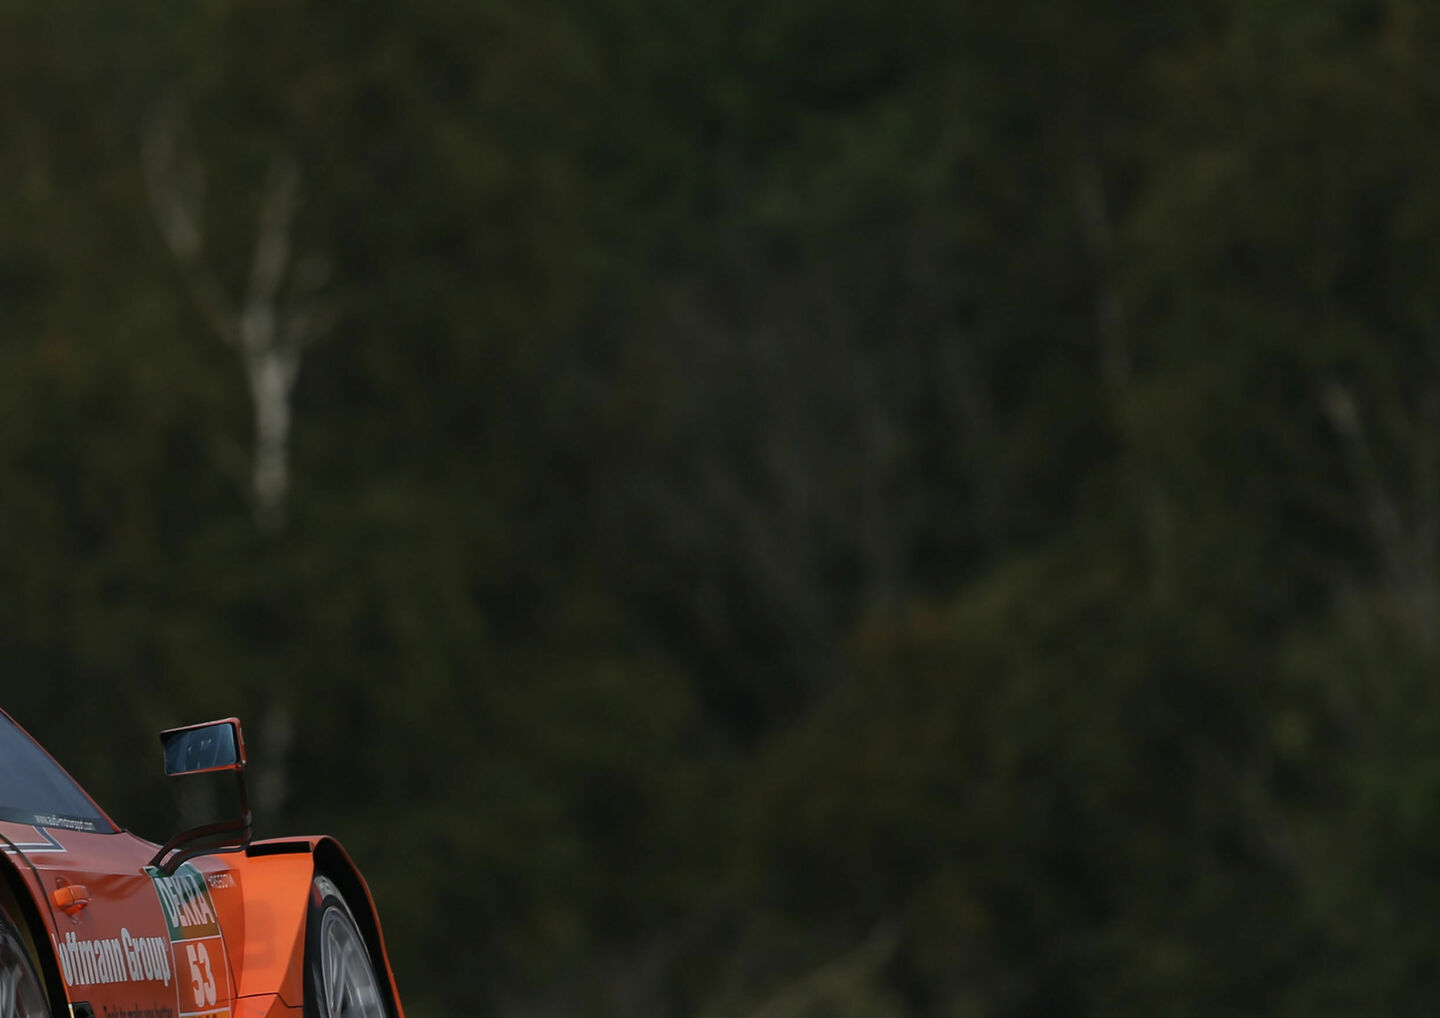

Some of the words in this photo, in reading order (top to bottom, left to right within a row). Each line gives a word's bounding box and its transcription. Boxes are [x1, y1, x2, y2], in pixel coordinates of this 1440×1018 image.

[154, 873, 216, 929] DEKRA
[52, 931, 128, 987] offmann
[121, 927, 171, 987] Group
[185, 942, 217, 1008] 53
